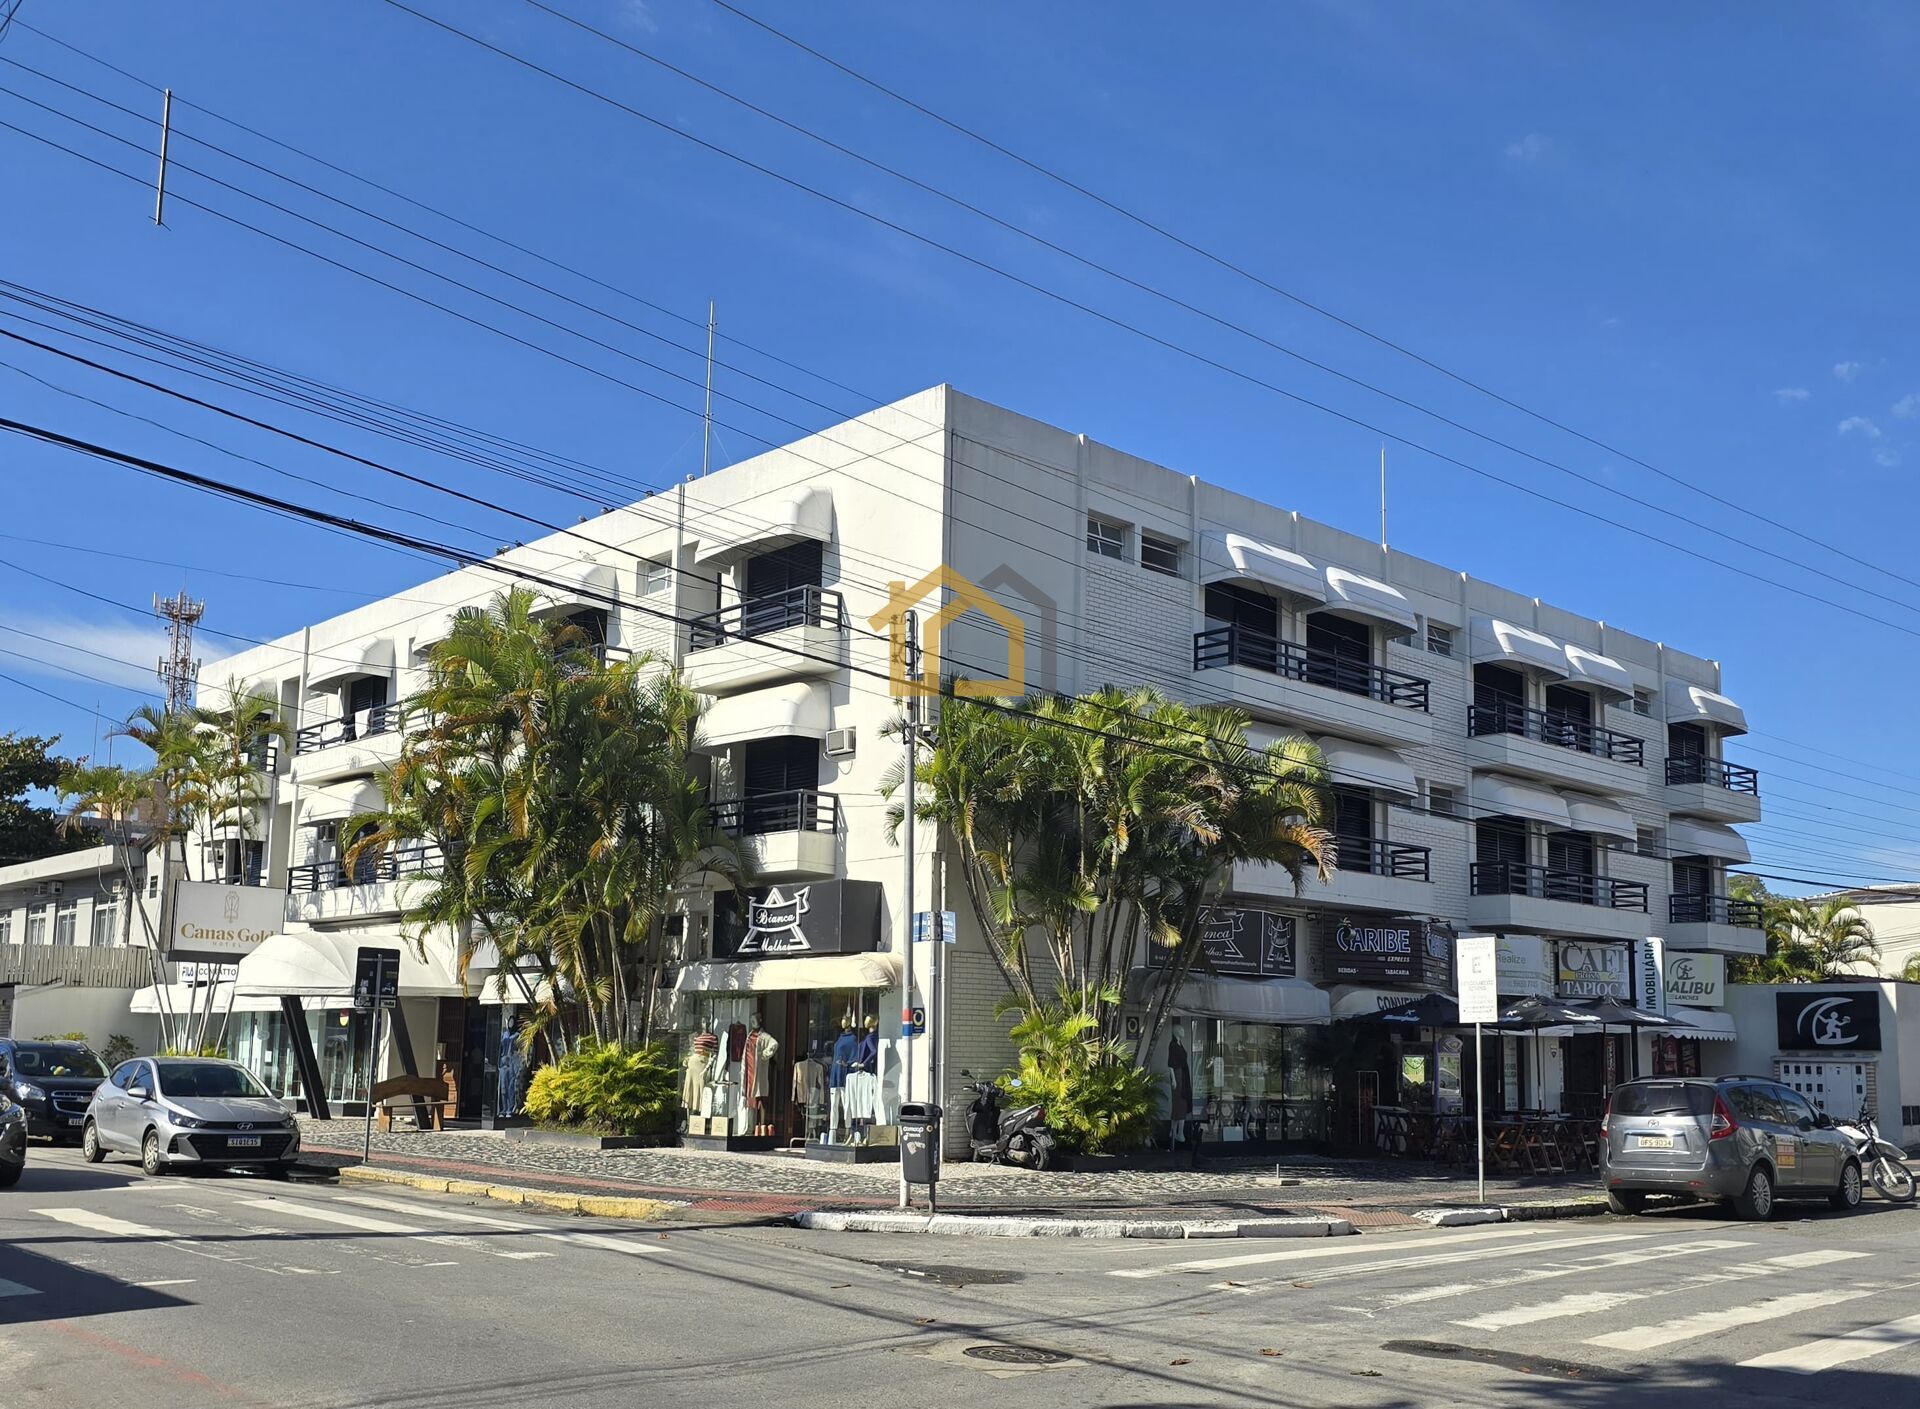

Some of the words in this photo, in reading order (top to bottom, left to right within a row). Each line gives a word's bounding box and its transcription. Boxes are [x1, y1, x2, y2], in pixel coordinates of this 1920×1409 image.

[755, 908, 796, 925] Bianca
[180, 922, 234, 941] Canas
[1336, 926, 1411, 953] CARIBE
[760, 937, 791, 952] Malhas
[1642, 941, 1656, 1009] IMOBILIÁRIA
